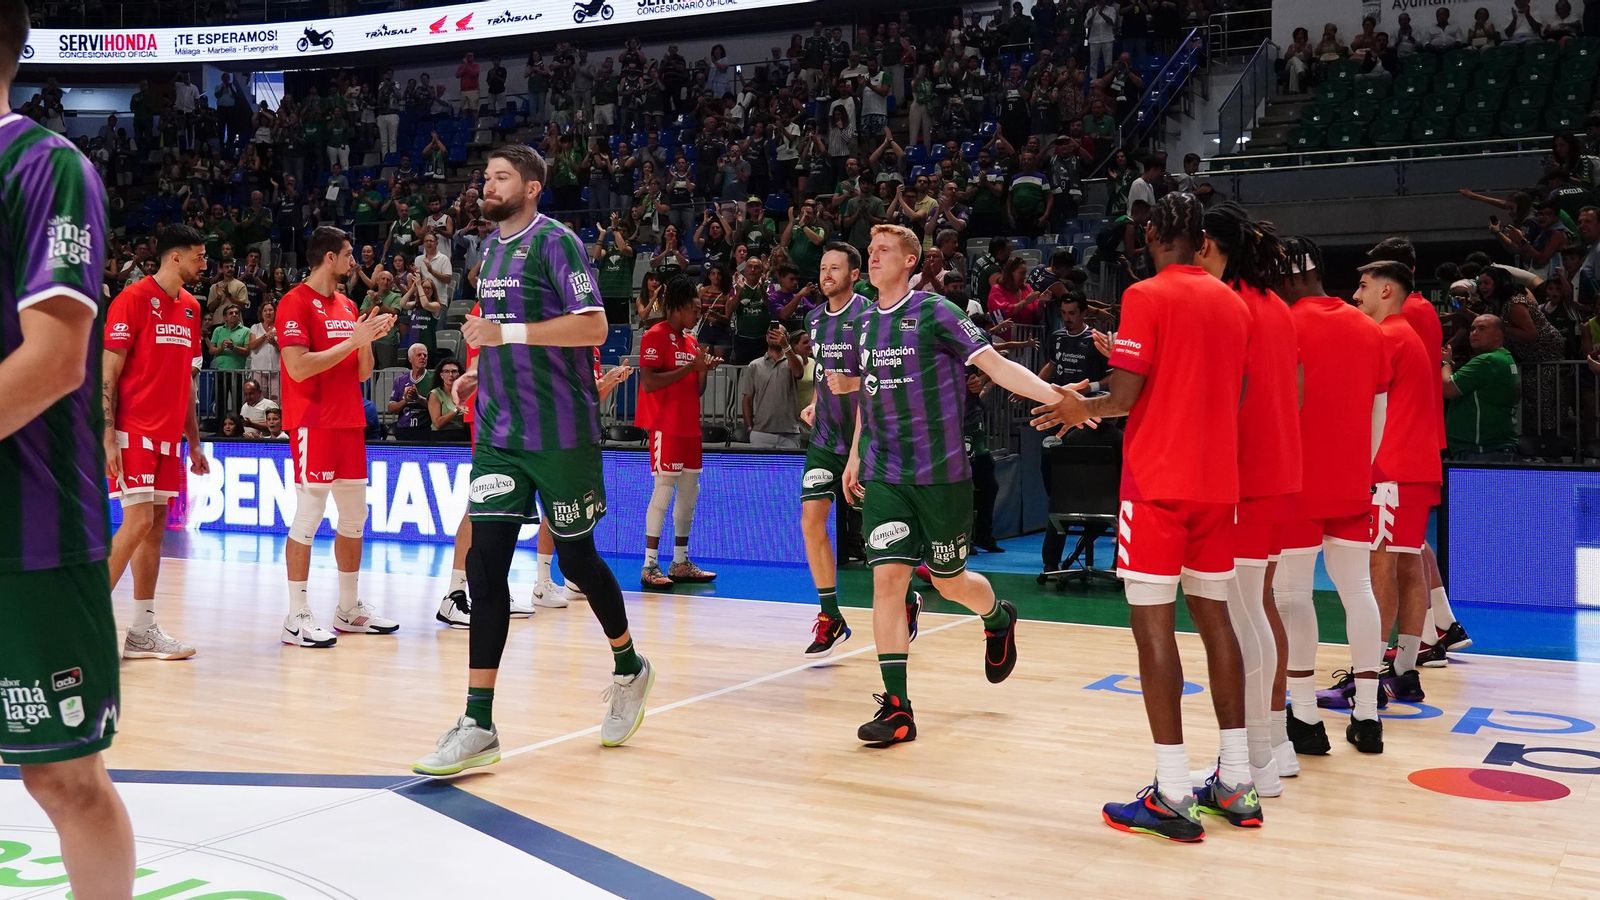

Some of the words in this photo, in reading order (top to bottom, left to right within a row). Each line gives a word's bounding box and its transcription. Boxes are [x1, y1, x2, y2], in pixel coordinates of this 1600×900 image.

[637, 2, 704, 15] CONCESIONARIO
[487, 13, 543, 26] TRANSALP
[197, 30, 278, 45] ESPERAMOS!
[365, 27, 417, 39] TRANSALP
[59, 33, 158, 51] SERVIHONDA
[207, 46, 237, 54] Marbella
[243, 44, 279, 53] Fuengirola
[481, 276, 520, 288] Fundación
[481, 287, 506, 300] Unicaja
[155, 323, 192, 339] GIRONA
[821, 342, 852, 351] Fundación
[872, 346, 915, 358] Fundación
[821, 350, 843, 359] Unicaja
[872, 356, 902, 368] Unicaja
[187, 456, 541, 541] BENHAV
[0, 677, 20, 687] abor
[56, 676, 76, 688] acb
